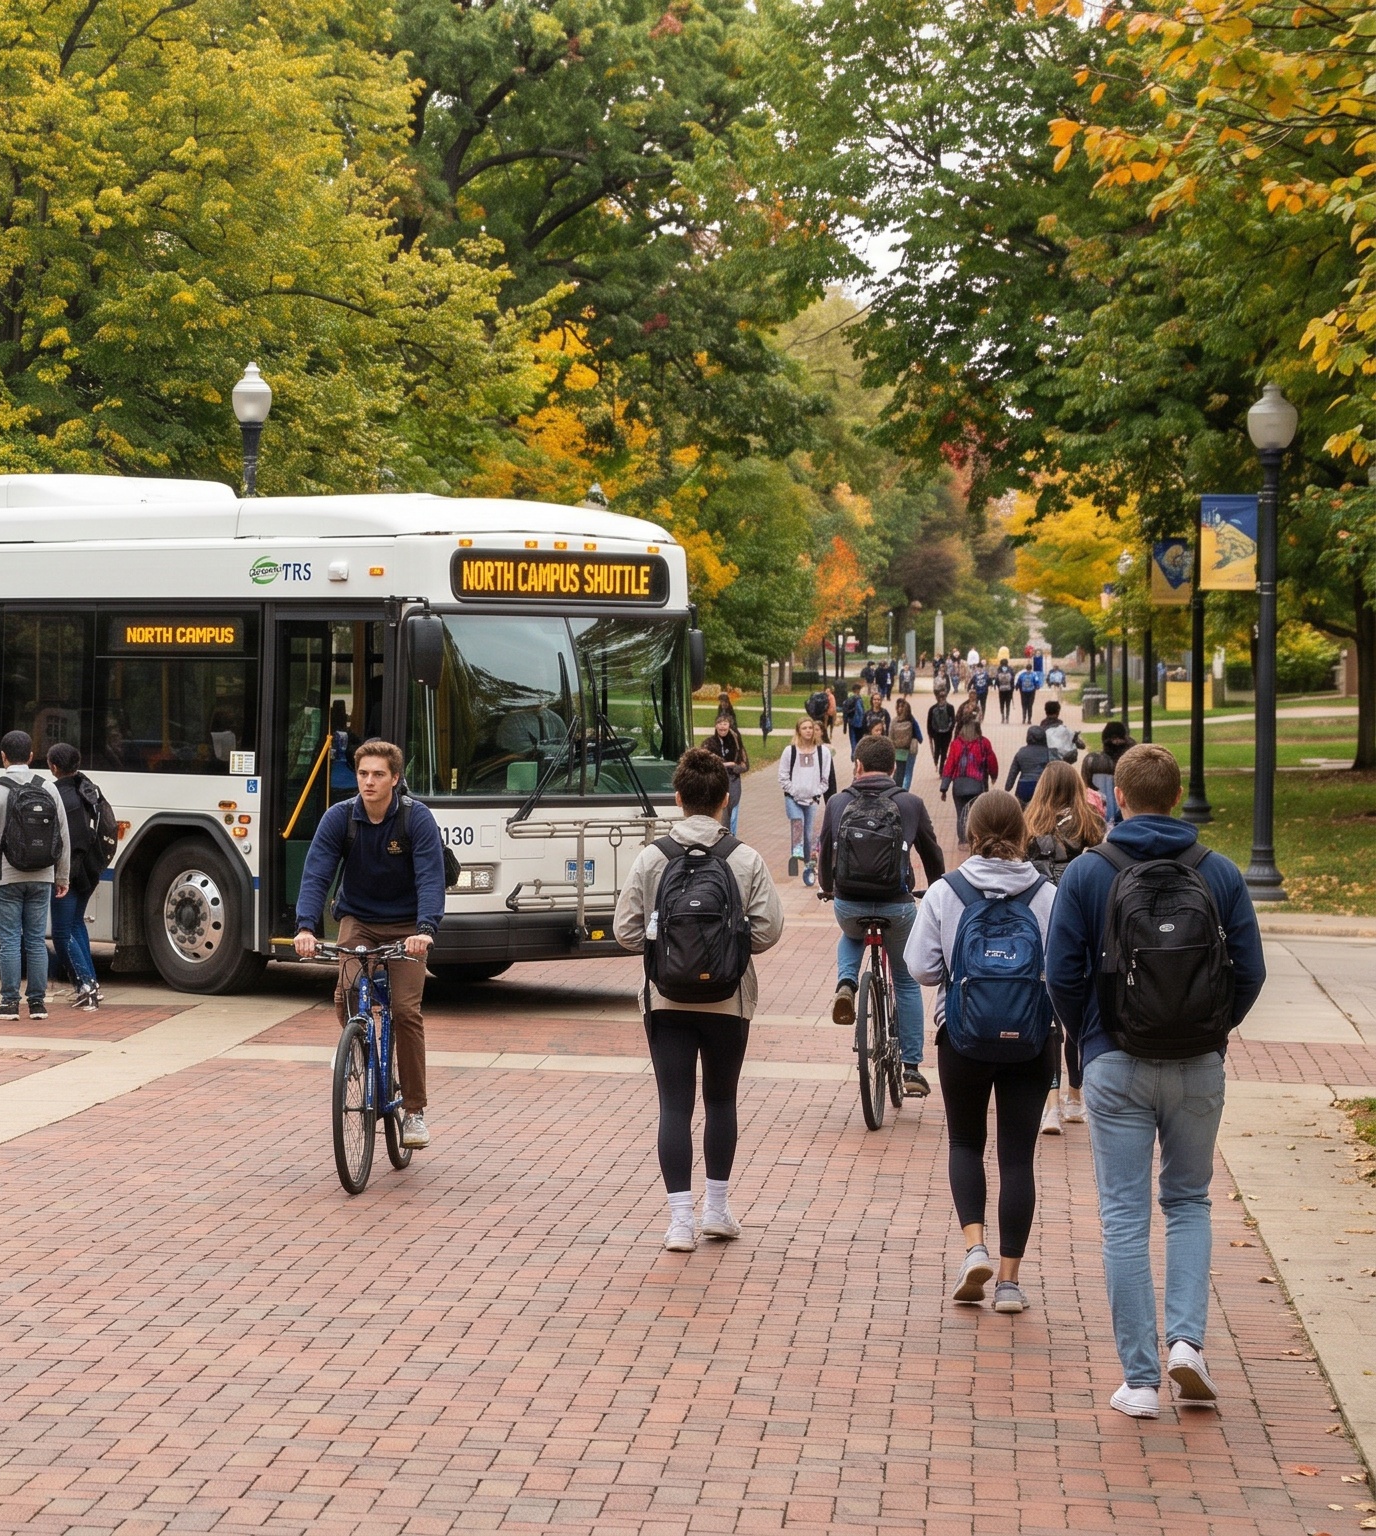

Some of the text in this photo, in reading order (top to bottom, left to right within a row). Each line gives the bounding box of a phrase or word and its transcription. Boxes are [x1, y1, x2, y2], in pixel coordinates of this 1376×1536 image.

[283, 563, 312, 581] TRS
[462, 560, 651, 595] NORTH CAMPUS SHUTTLE
[126, 627, 234, 644] NORTH CAMPUS
